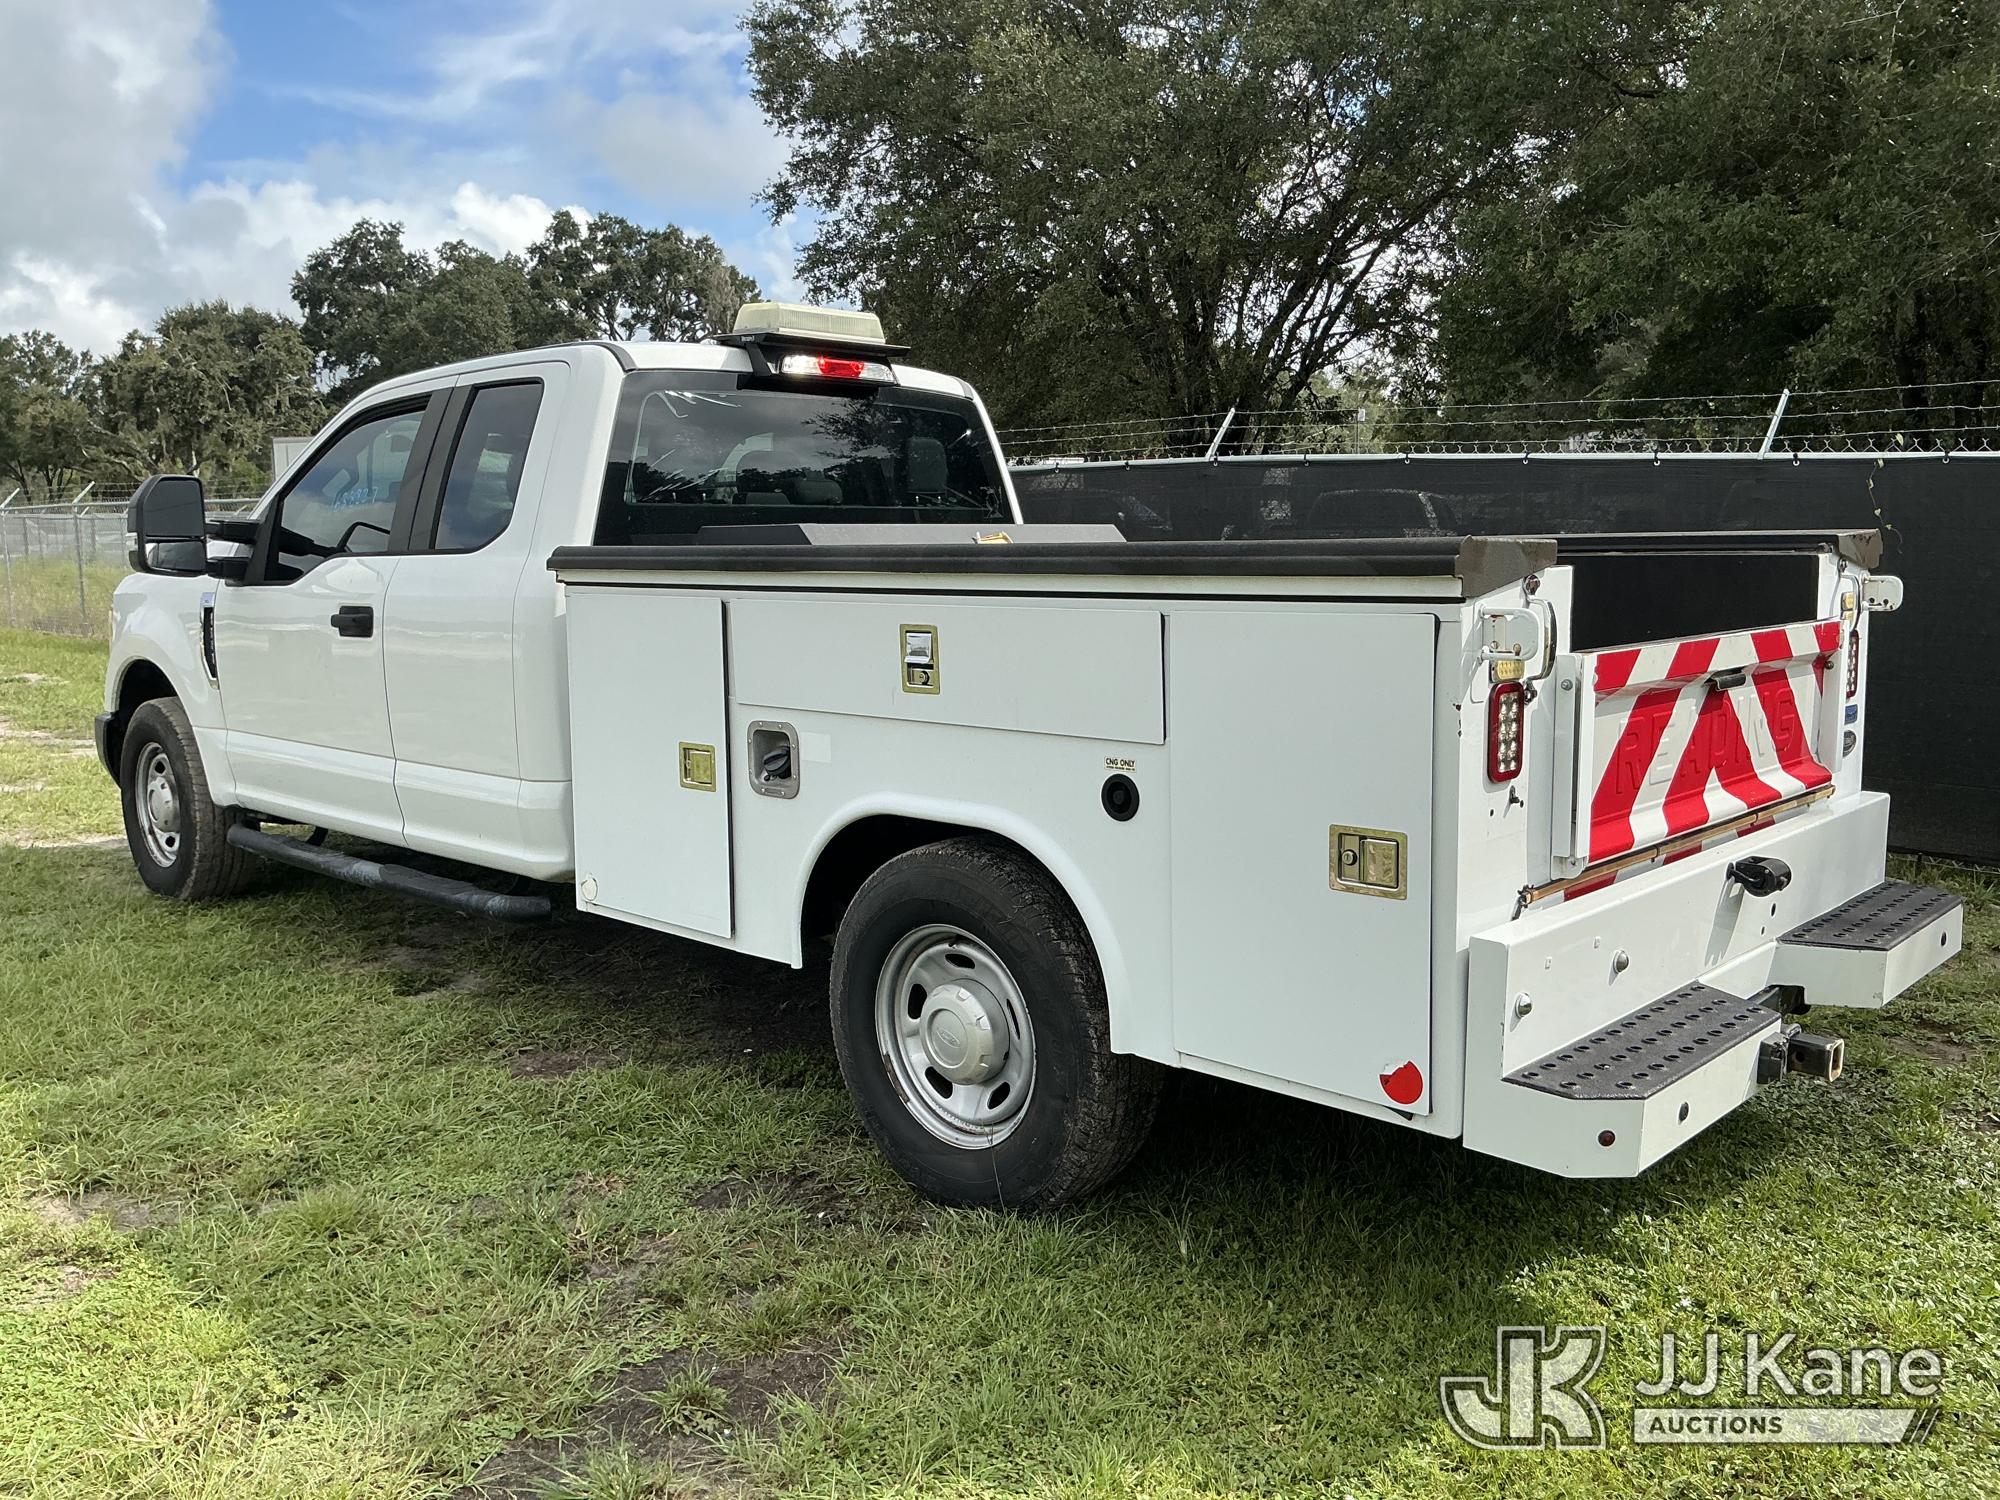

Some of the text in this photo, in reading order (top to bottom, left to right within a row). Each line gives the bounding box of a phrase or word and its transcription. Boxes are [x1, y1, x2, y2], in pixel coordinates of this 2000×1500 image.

[1105, 757, 1135, 767] CNG ONLY
[1615, 687, 1798, 795] READING
